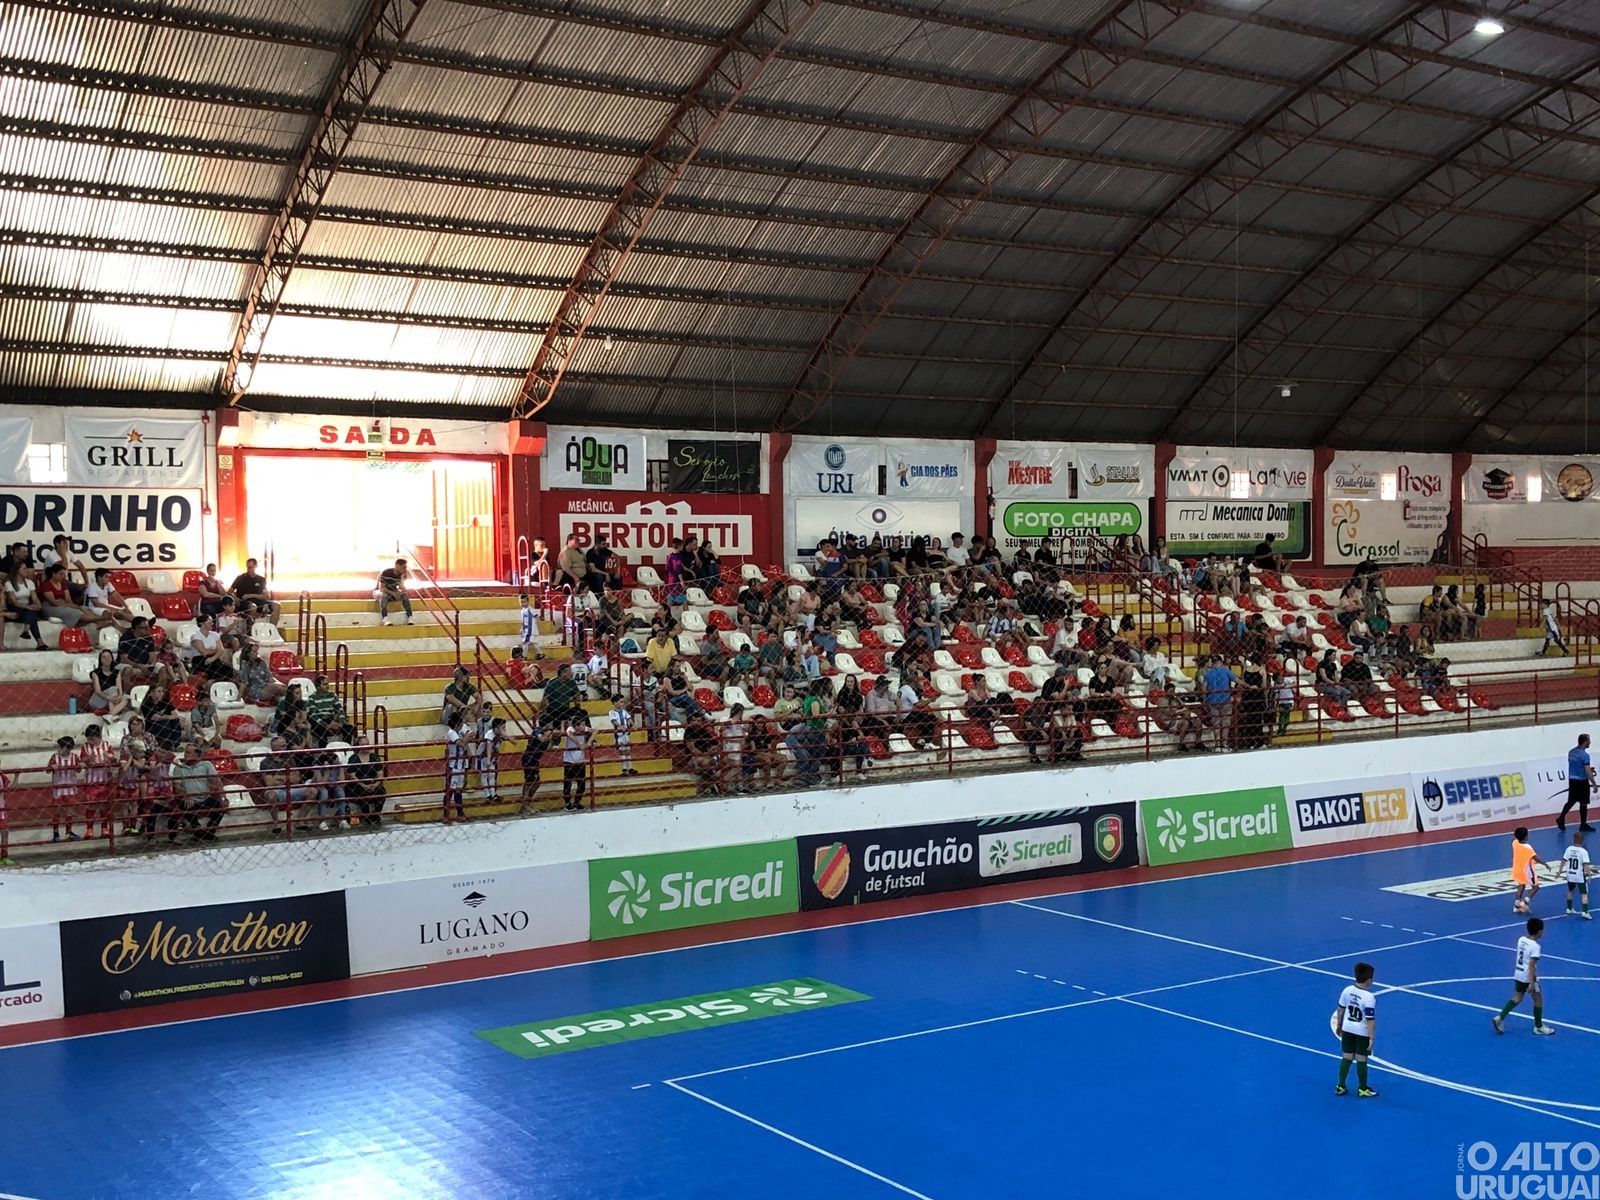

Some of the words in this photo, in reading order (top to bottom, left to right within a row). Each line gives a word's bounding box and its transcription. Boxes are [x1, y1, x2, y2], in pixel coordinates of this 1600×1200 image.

[87, 446, 183, 467] GRILL
[911, 466, 923, 477] CIA
[925, 466, 939, 477] DOS
[941, 464, 958, 477] PÃES
[1283, 471, 1306, 485] Vie
[1398, 465, 1441, 497] Prosa
[817, 473, 853, 494] URI
[568, 498, 614, 512] MECÂNICA
[1267, 503, 1296, 522] Donin
[1013, 511, 1064, 528] FOTO
[1071, 511, 1133, 527] CHAPA
[828, 527, 867, 549] Óta
[875, 531, 931, 549] méria
[1052, 528, 1099, 537] DIGITAL
[1337, 518, 1399, 557] Girassol
[1192, 803, 1279, 843] Sicredi
[864, 837, 974, 872] Gauchão
[1012, 835, 1073, 861] Sicredi
[1568, 858, 1579, 870] 10
[660, 860, 784, 911] Sicredi
[866, 877, 882, 893] de
[883, 876, 925, 894] futsal
[419, 910, 529, 944] LUGANO
[140, 911, 313, 966] Marathon
[447, 941, 505, 956] GRAMADO
[521, 998, 749, 1048] Sicredi
